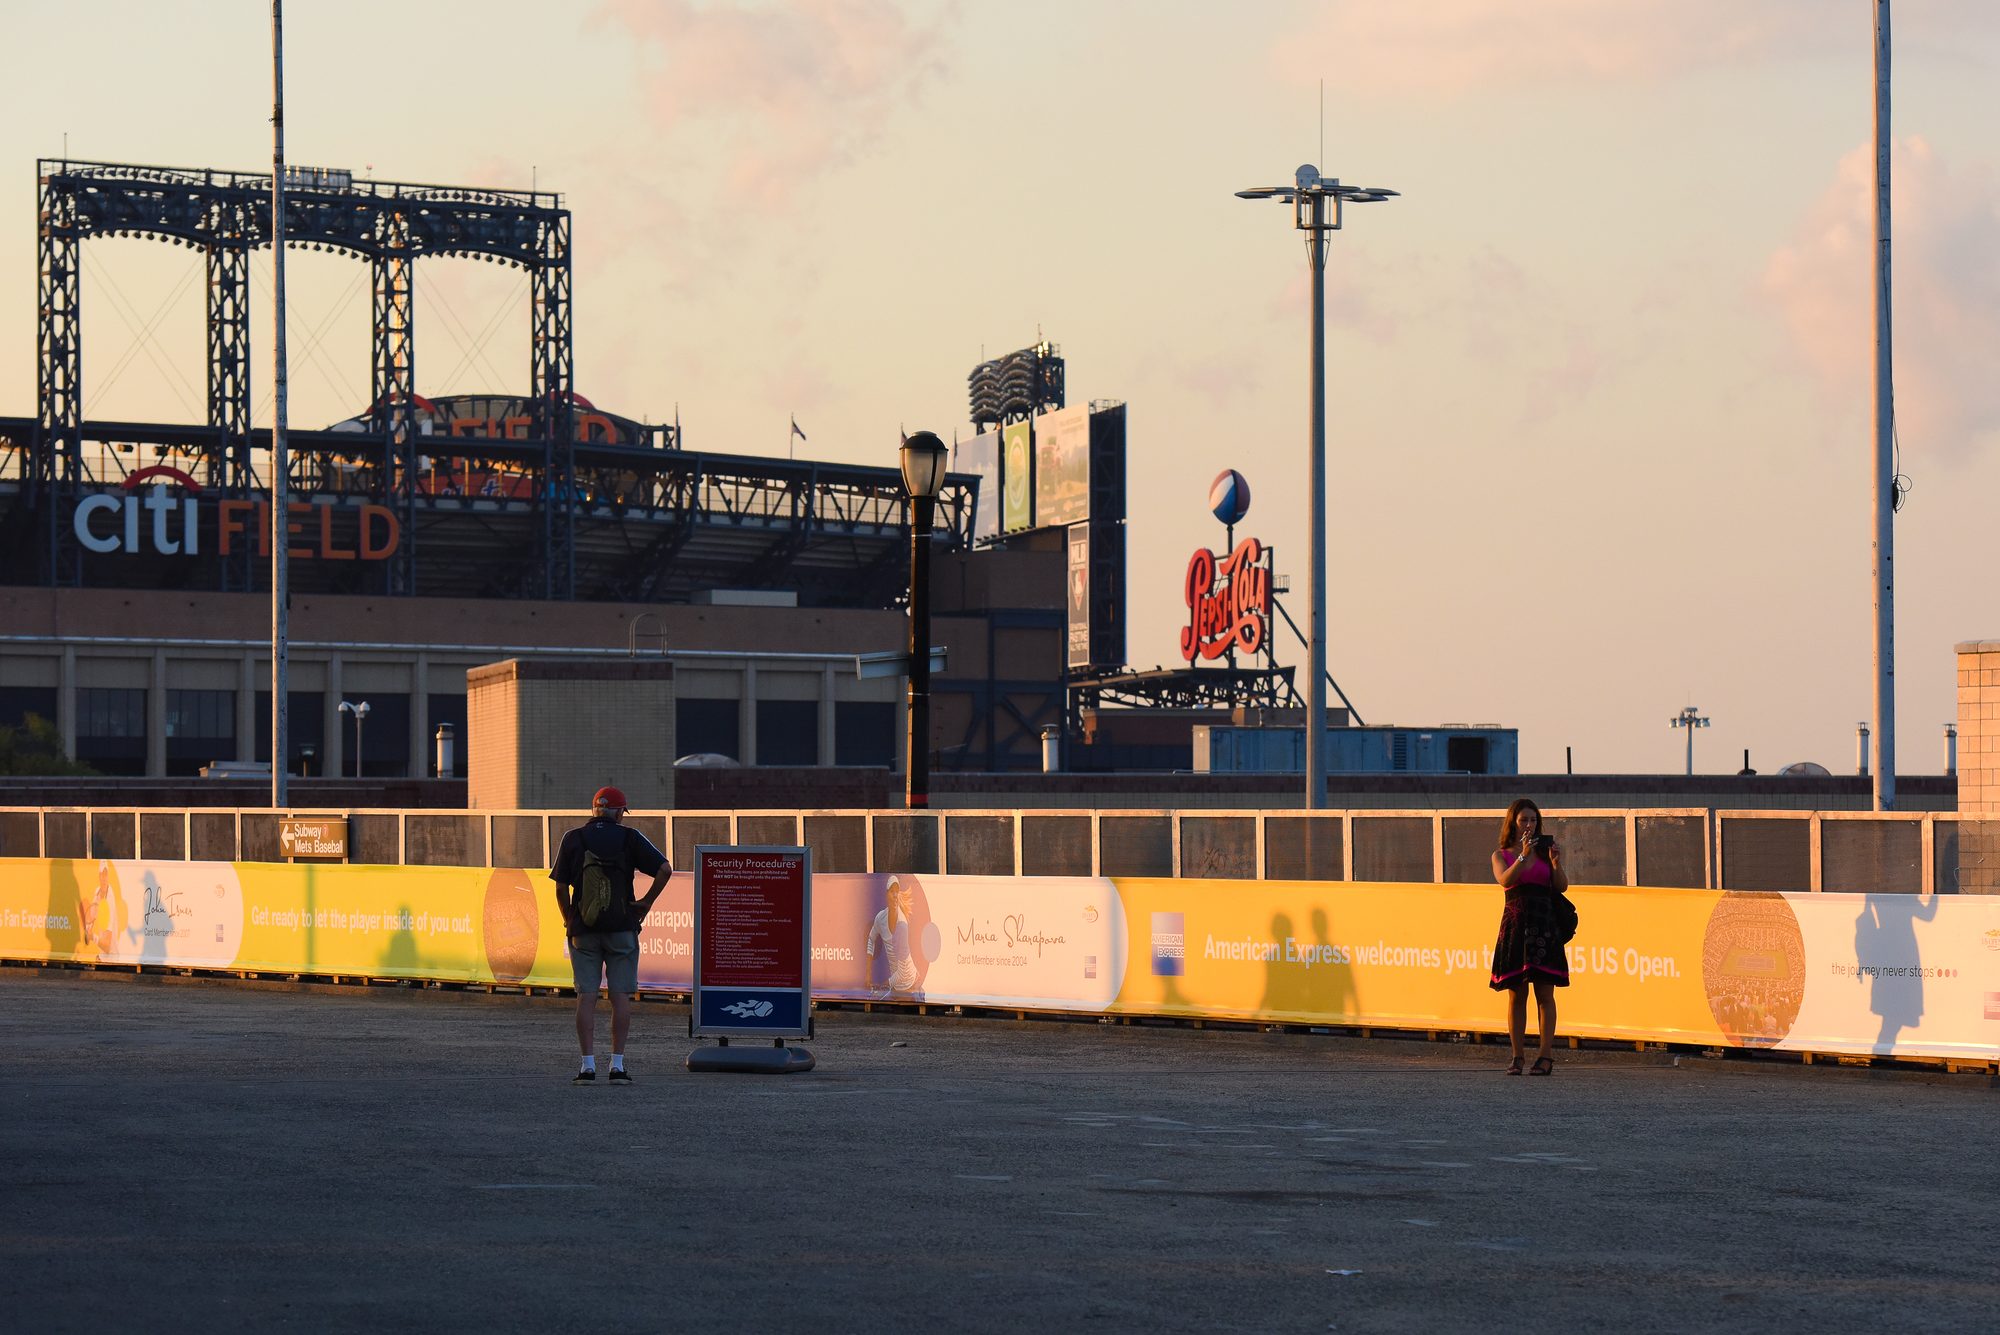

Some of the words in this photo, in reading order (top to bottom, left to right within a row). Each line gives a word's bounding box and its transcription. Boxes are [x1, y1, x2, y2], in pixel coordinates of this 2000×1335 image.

[74, 482, 198, 555] citi
[219, 499, 400, 560] FIELD
[294, 823, 322, 840] Subway
[294, 839, 312, 853] Mets
[314, 839, 343, 853] Baseball
[707, 858, 744, 869] Security
[745, 858, 797, 869] Procedures
[143, 886, 166, 926] John
[4, 908, 20, 928] Fan
[21, 908, 72, 934] Experience.
[251, 905, 269, 926] Get
[271, 907, 299, 932] ready
[302, 908, 313, 928] to
[314, 907, 328, 928] let
[330, 908, 347, 929] the
[349, 909, 381, 935] player
[383, 909, 414, 931] inside
[416, 911, 428, 931] of
[430, 916, 449, 937] you
[452, 913, 474, 934] out.
[957, 917, 998, 946] Maria
[1003, 913, 1067, 959] Sharapova
[1152, 934, 1184, 945] AMERICAN
[650, 938, 663, 955] US
[665, 938, 690, 960] Open
[1158, 946, 1184, 958] EXPRESS
[1204, 933, 1281, 961] American
[1285, 936, 1350, 969] Express
[1354, 939, 1441, 968] welcomes
[1444, 948, 1478, 975] you
[1564, 946, 1587, 973] 15
[1591, 946, 1618, 975] US
[1623, 947, 1681, 984] Open.
[956, 954, 971, 965] Card
[972, 954, 995, 966] Member
[996, 955, 1011, 967] since
[1012, 955, 1027, 967] 2004
[1831, 962, 1846, 975] the
[1847, 964, 1880, 980] journey
[1882, 966, 1908, 977] never
[1909, 965, 1935, 980] stops
